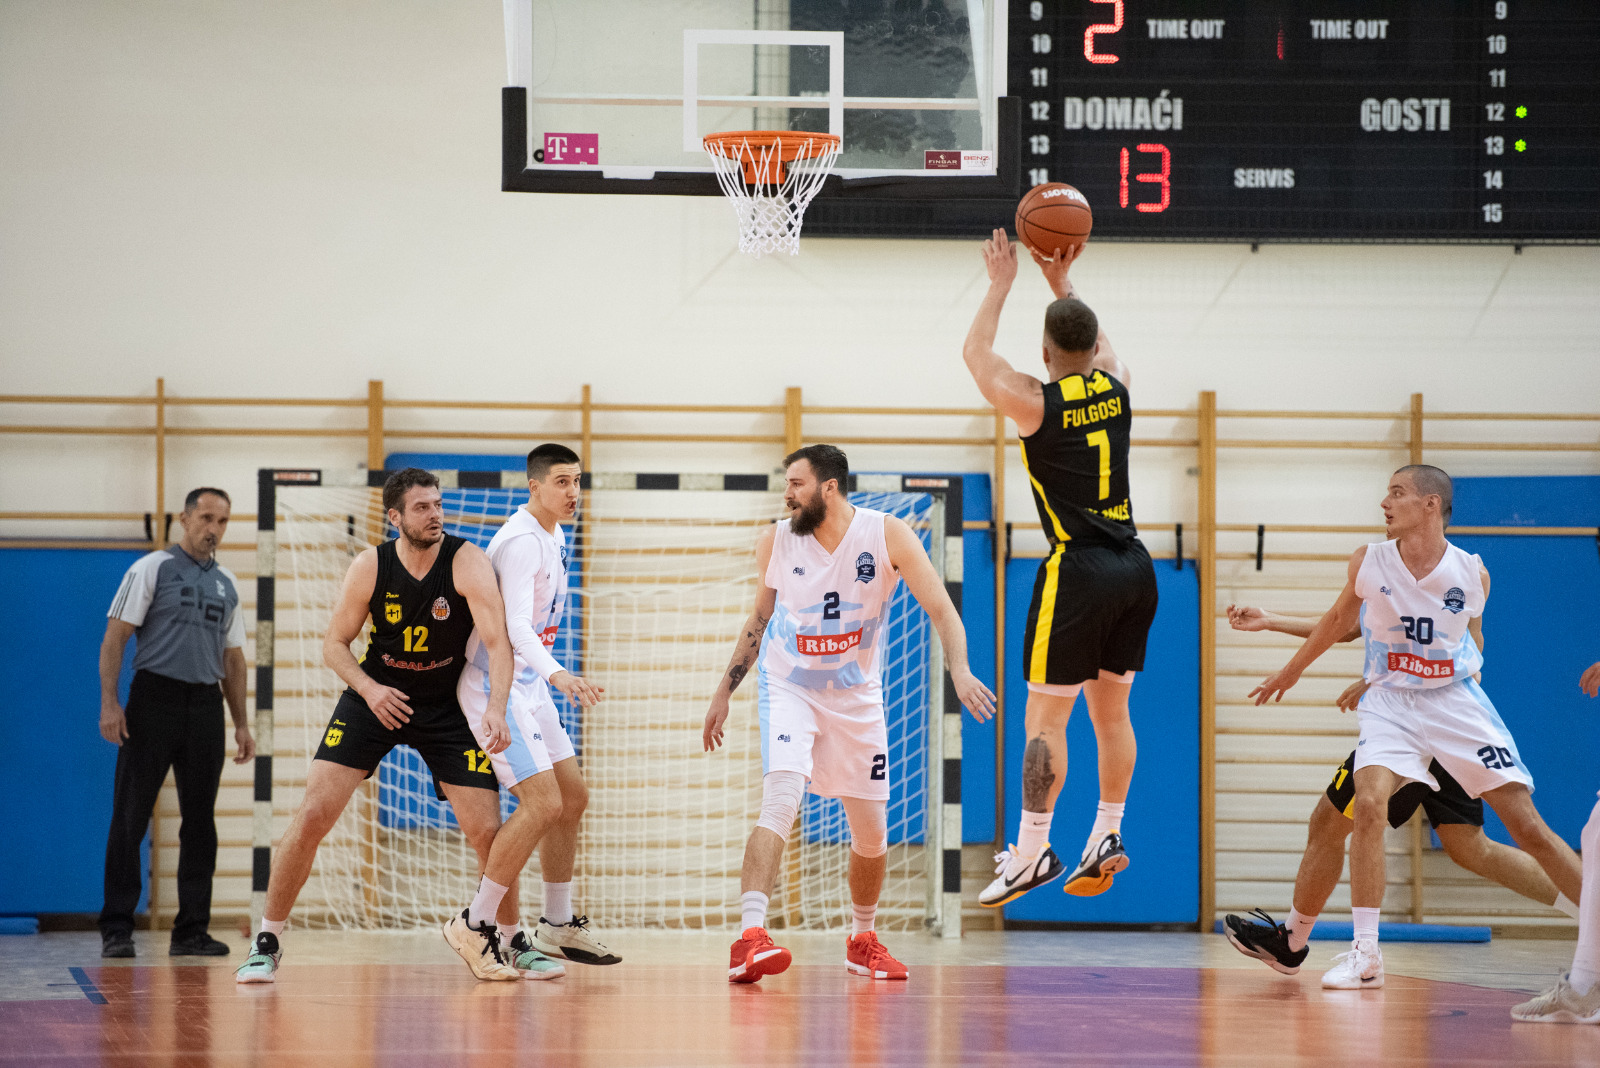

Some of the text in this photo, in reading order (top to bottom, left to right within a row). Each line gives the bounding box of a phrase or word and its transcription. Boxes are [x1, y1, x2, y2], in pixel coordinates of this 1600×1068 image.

[1030, 1, 1043, 21] 9
[1495, 1, 1508, 20] 9
[1147, 19, 1225, 39] TIME OUT
[1310, 19, 1389, 39] TIME OUT
[1031, 34, 1051, 54] 10
[1486, 34, 1507, 54] 10
[1030, 67, 1048, 87] 11
[1488, 68, 1506, 88] 11
[1029, 101, 1050, 121] 12
[1064, 89, 1183, 131] DOMAĆI
[1360, 97, 1450, 132] GOSTI
[1485, 102, 1505, 122] 12
[1029, 135, 1050, 155] 13
[1483, 136, 1504, 156] 13
[1028, 168, 1049, 187] 14
[1119, 143, 1171, 212] 13
[1234, 168, 1295, 188] SERVIS
[1483, 170, 1503, 190] 14
[1482, 203, 1503, 223] 15
[1062, 396, 1122, 429] FULGOSI
[1086, 429, 1111, 501] 7
[823, 591, 840, 620] 2
[402, 626, 429, 652] 12
[1400, 616, 1434, 645] 20
[1398, 656, 1451, 676] Ribola
[463, 749, 492, 775] 12
[870, 754, 886, 780] 2
[1477, 746, 1514, 769] 20
